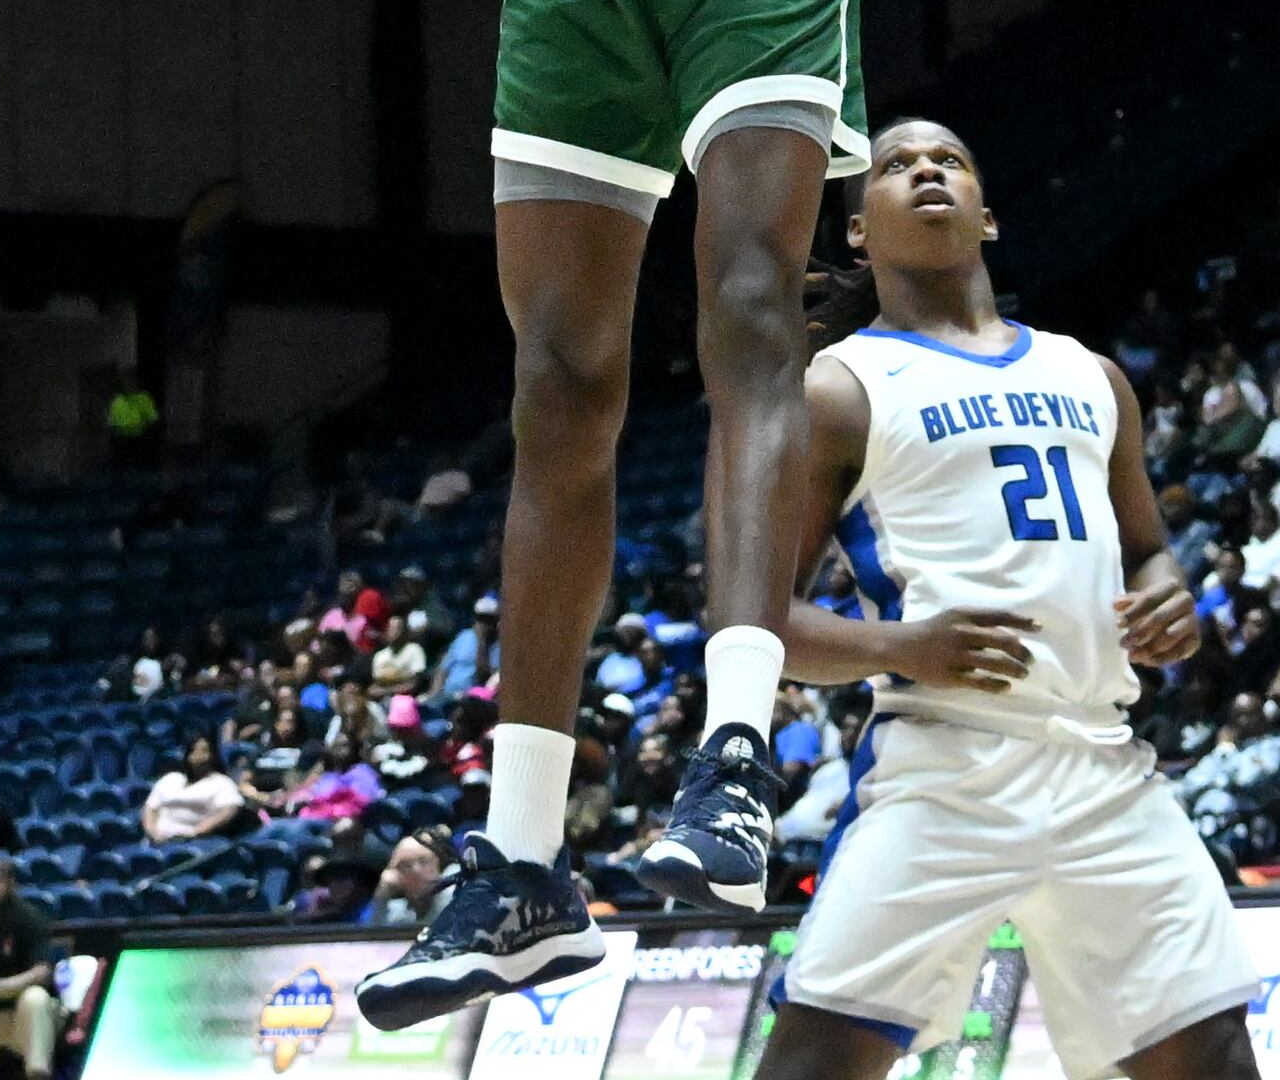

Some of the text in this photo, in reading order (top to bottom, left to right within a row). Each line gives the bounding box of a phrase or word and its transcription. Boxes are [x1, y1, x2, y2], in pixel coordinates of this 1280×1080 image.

[920, 393, 1100, 443] BLUE DEVILS
[990, 445, 1087, 541] 21
[628, 946, 764, 980] REENFORES
[646, 1006, 713, 1072] 45
